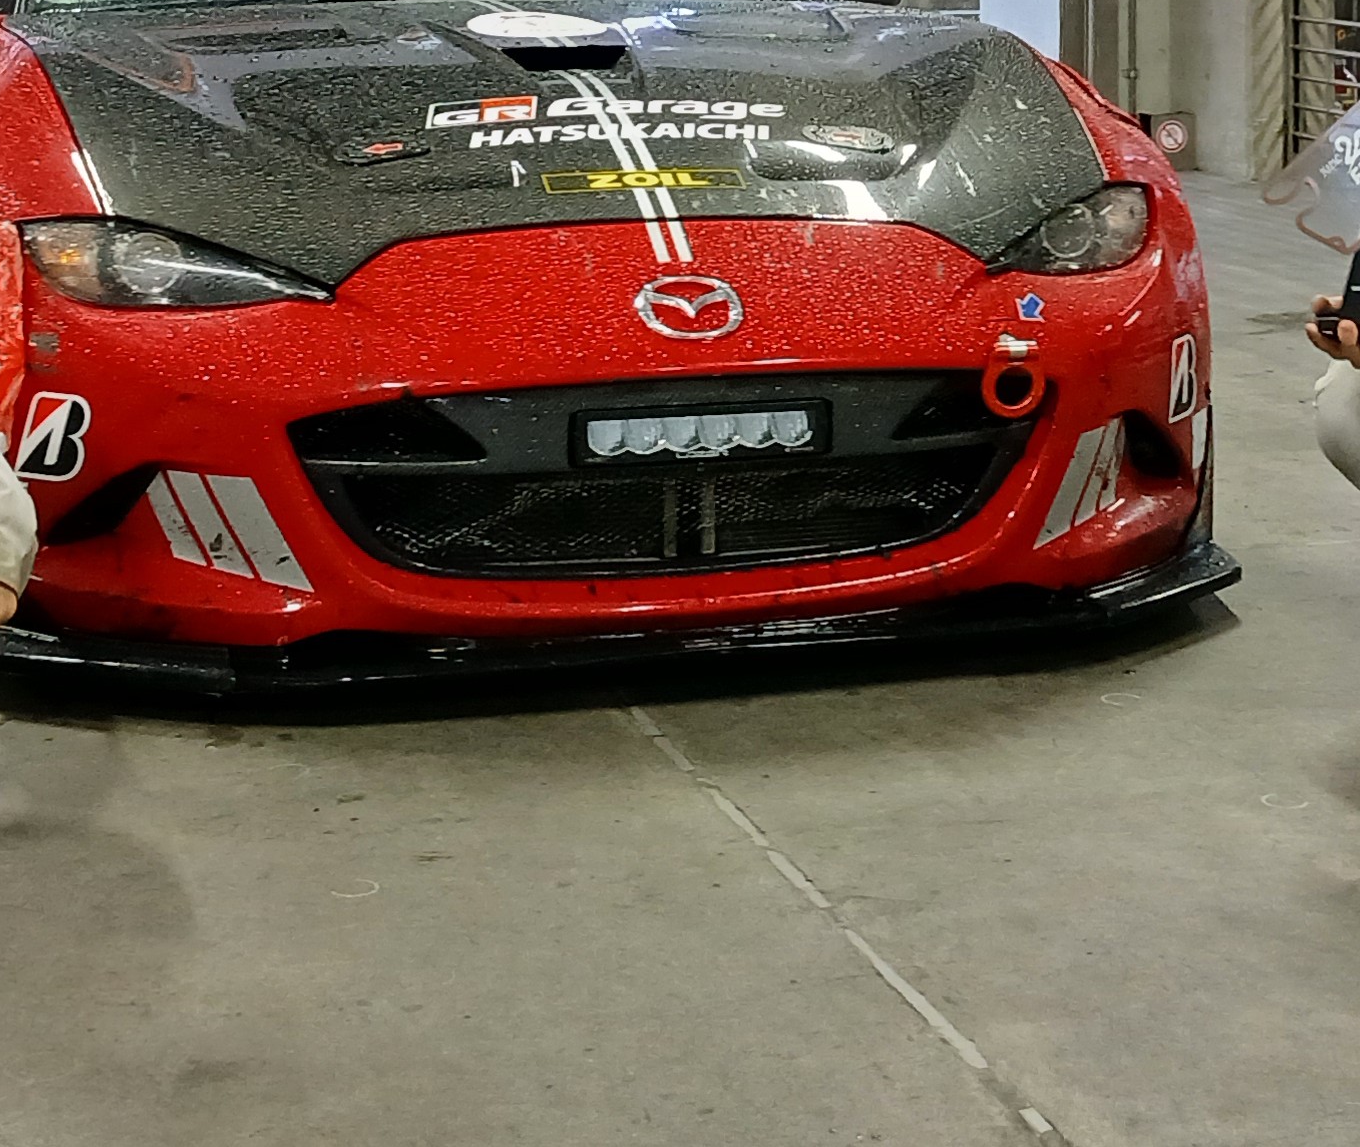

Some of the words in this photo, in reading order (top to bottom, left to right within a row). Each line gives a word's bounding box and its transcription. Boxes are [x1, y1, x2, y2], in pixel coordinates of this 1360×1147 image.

[432, 104, 534, 126] GR
[546, 97, 787, 120] Garage
[468, 122, 770, 149] HATSUKAICHI
[586, 172, 710, 189] ZOIL
